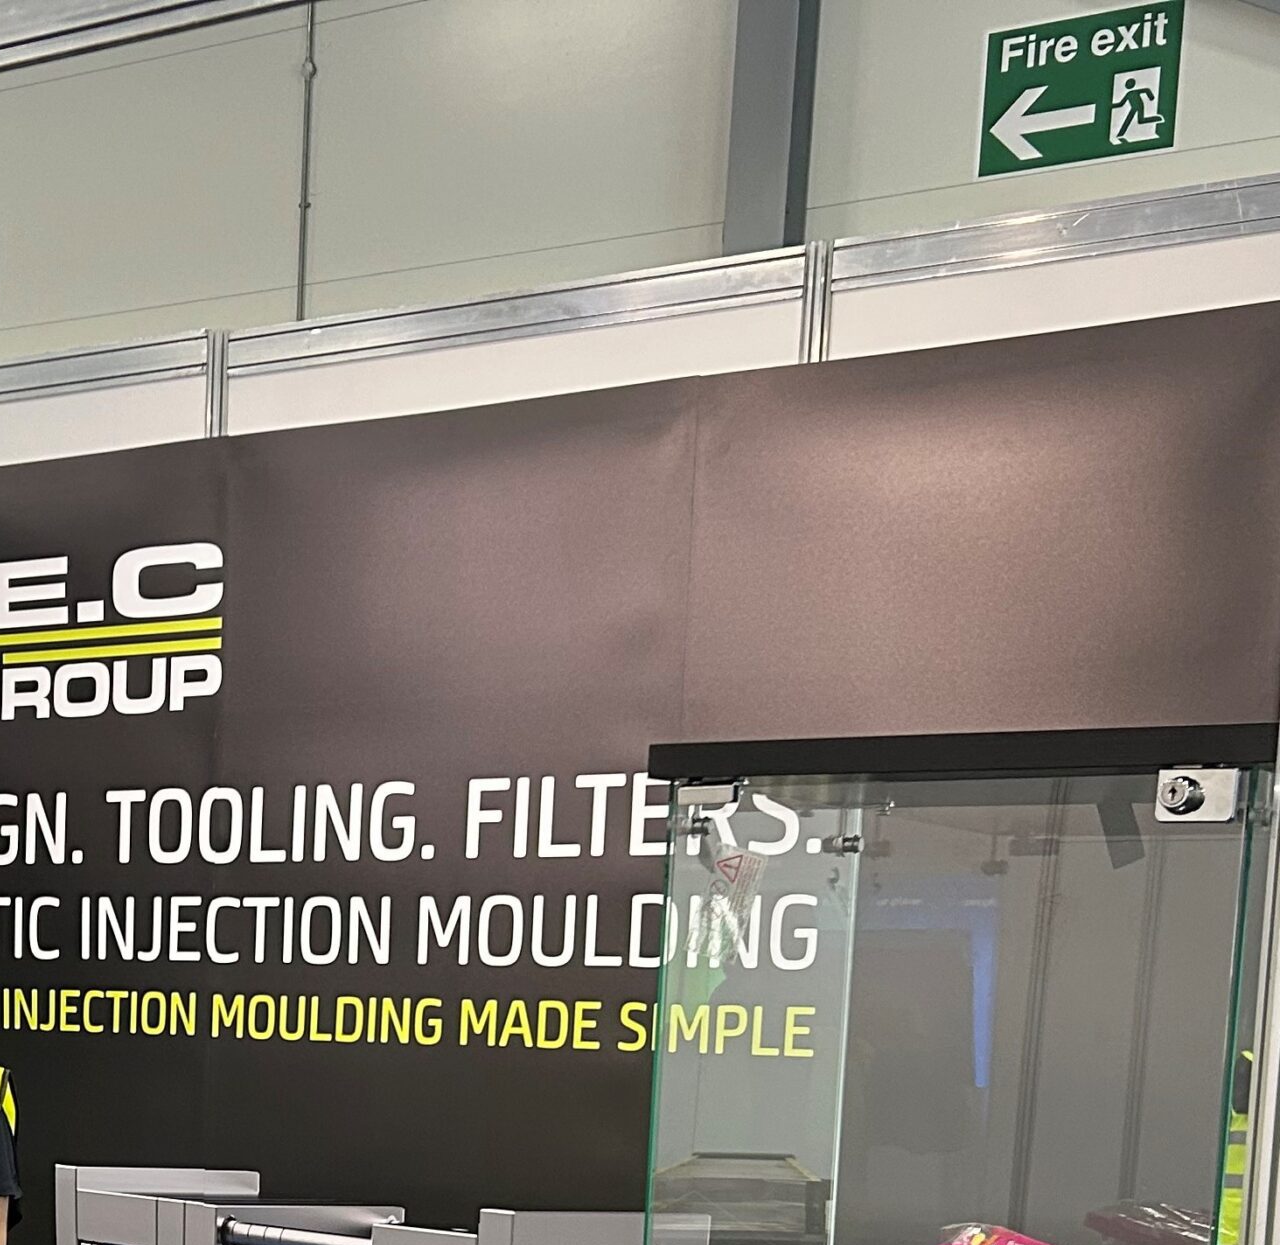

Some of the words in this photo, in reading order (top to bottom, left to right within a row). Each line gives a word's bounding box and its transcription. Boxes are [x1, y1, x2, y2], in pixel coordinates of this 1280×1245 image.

[1000, 34, 1078, 73] Fire
[1090, 12, 1169, 56] exit
[106, 780, 435, 864] TOOLING.
[81, 895, 392, 965] INJECTION
[417, 893, 819, 971] MOULDING
[3, 988, 197, 1036] INJECTION
[211, 994, 443, 1046] MOULDING
[460, 998, 602, 1050] MADE
[618, 1001, 817, 1058] SIMPLE
